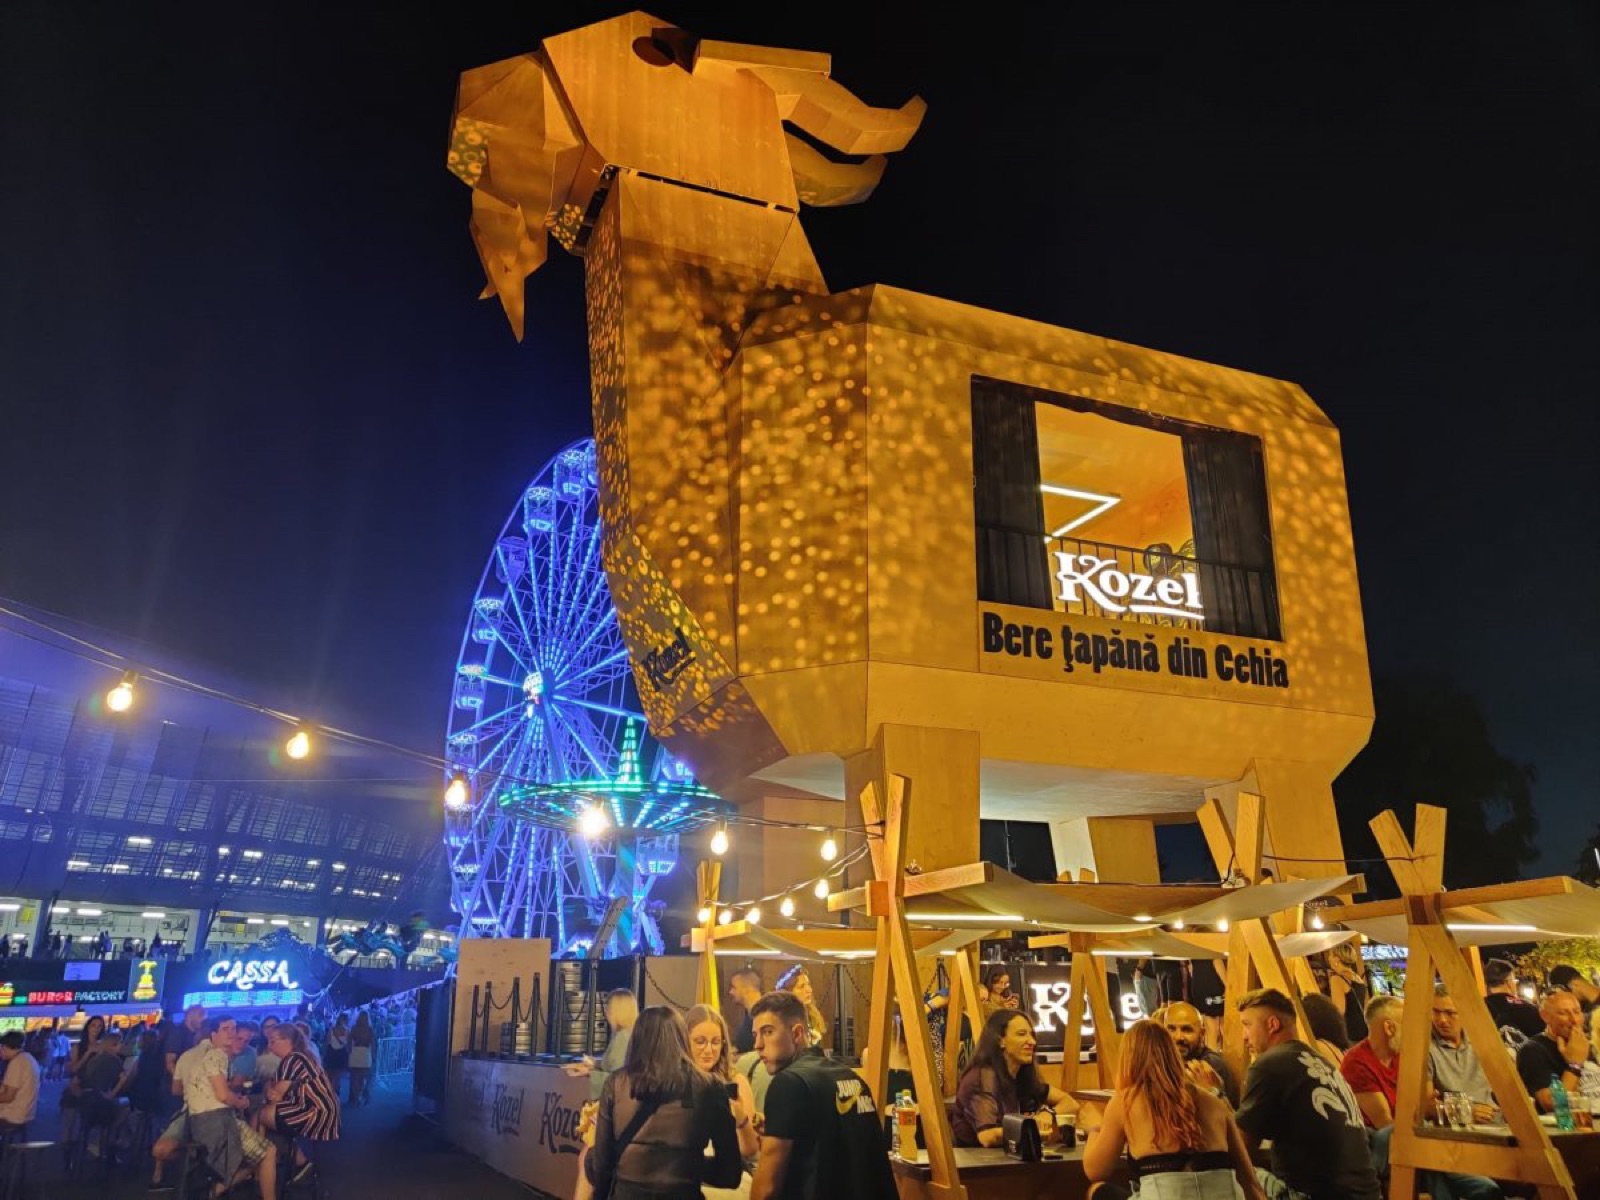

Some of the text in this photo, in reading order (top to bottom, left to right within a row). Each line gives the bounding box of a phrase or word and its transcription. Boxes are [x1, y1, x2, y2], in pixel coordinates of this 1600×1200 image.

[1053, 551, 1205, 620] Kozel
[641, 627, 696, 692] Kozel
[983, 611, 1052, 660] Bere
[1167, 636, 1208, 680] din
[1214, 643, 1289, 688] Cehia
[208, 960, 299, 990] CASSA
[491, 1084, 525, 1136] Kozel
